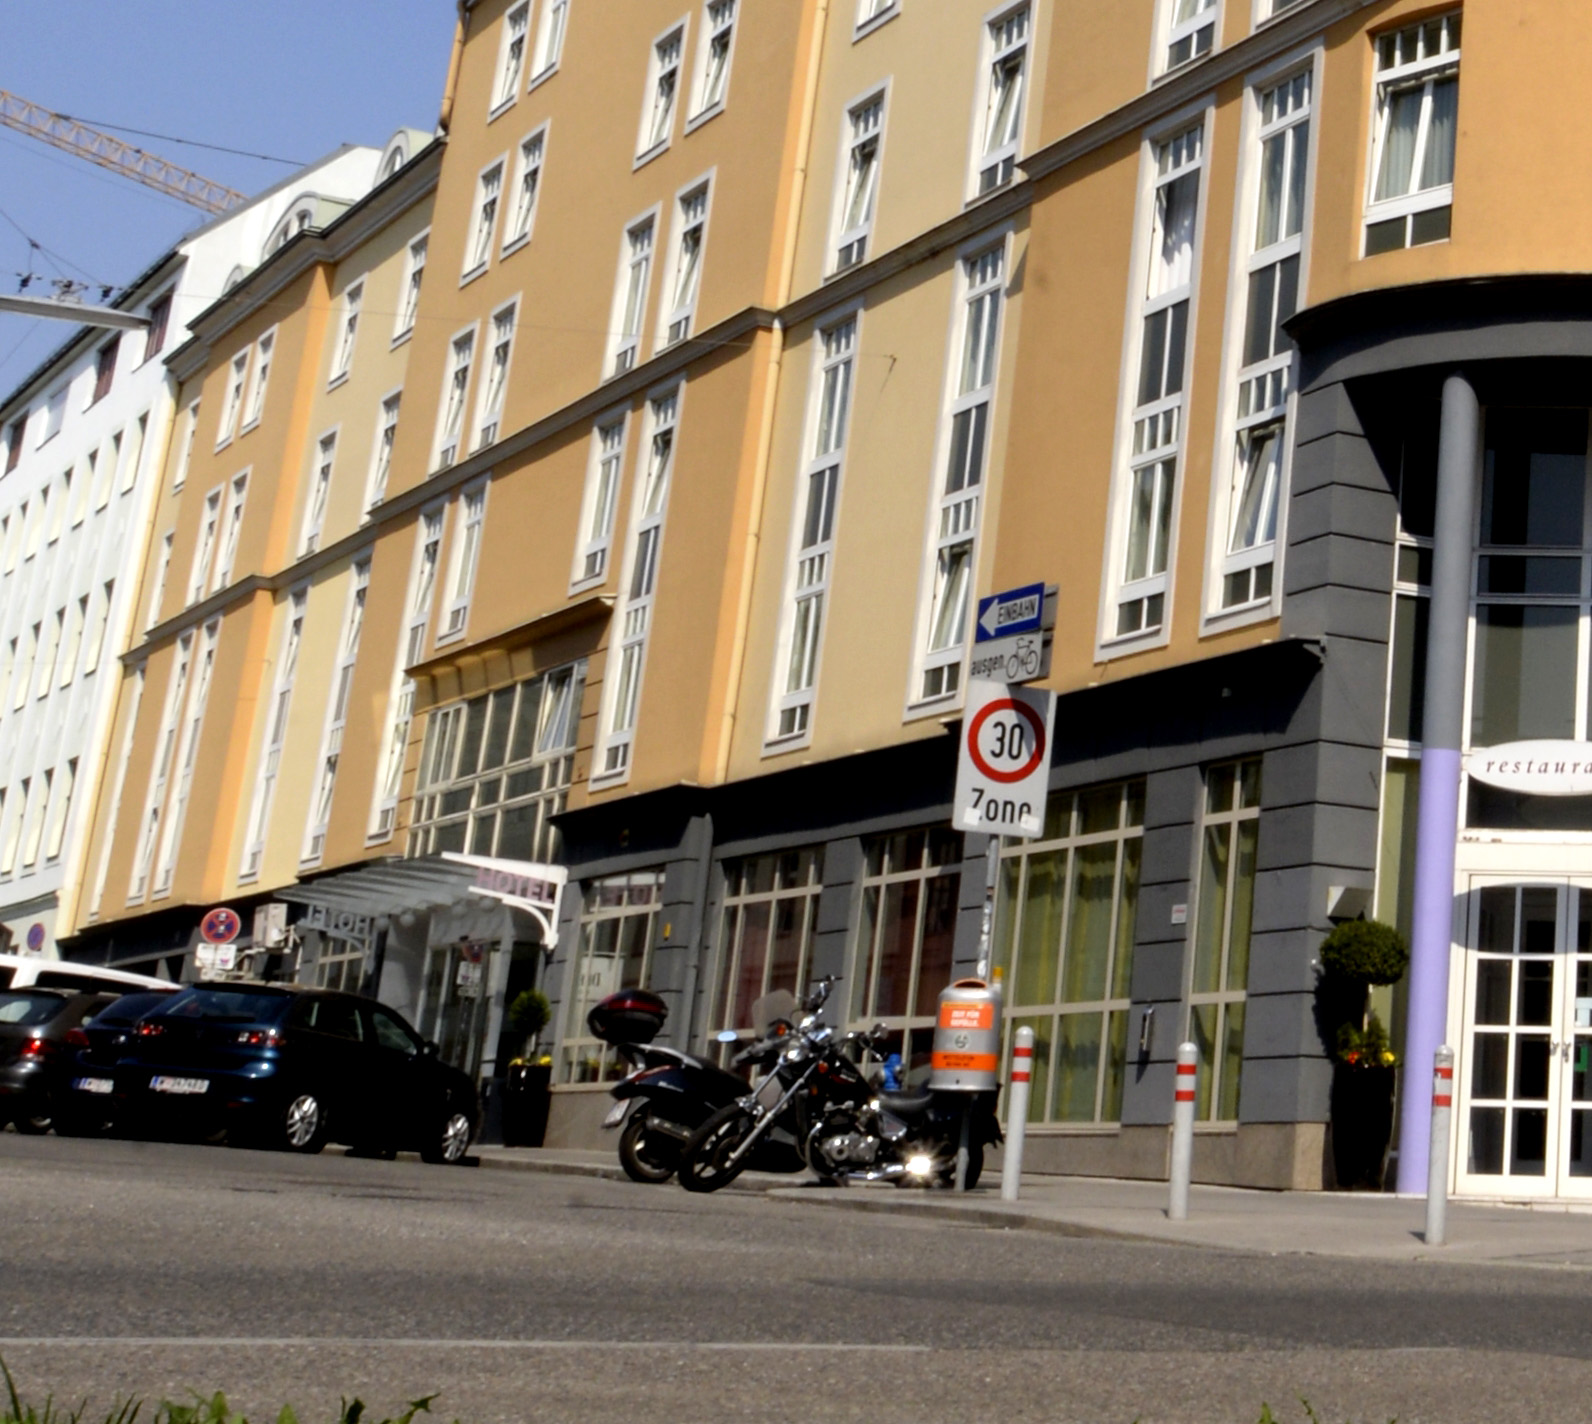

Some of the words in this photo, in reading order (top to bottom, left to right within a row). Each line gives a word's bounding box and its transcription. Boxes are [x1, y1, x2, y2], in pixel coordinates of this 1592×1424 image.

[998, 597, 1037, 624] EINBAHN
[990, 721, 1024, 760] 30
[476, 867, 554, 903] HOTEL
